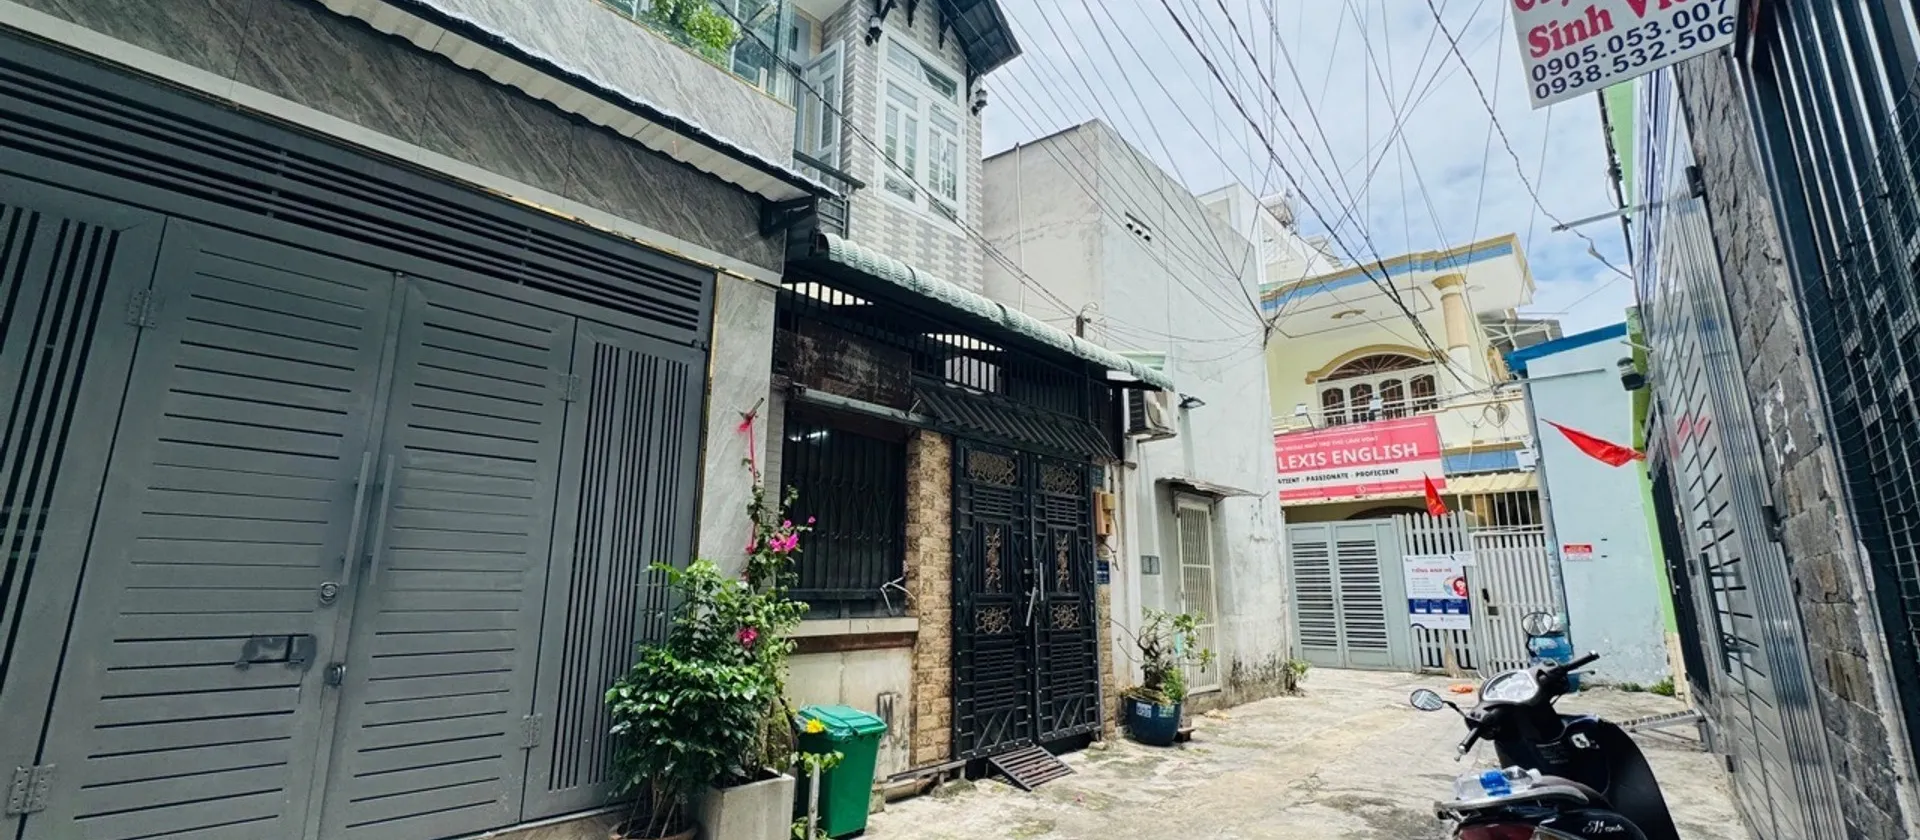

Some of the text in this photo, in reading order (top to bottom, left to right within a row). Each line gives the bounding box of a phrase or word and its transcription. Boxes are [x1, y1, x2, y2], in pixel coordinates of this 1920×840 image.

[1528, 5, 1613, 58] Sinh
[1532, 0, 1729, 82] 0905.053.007
[1535, 16, 1734, 99] 0938.532.506
[1306, 473, 1349, 482] PASSIONATE
[1355, 468, 1399, 478] PROFICIENT
[1332, 443, 1418, 464] ENGLISH
